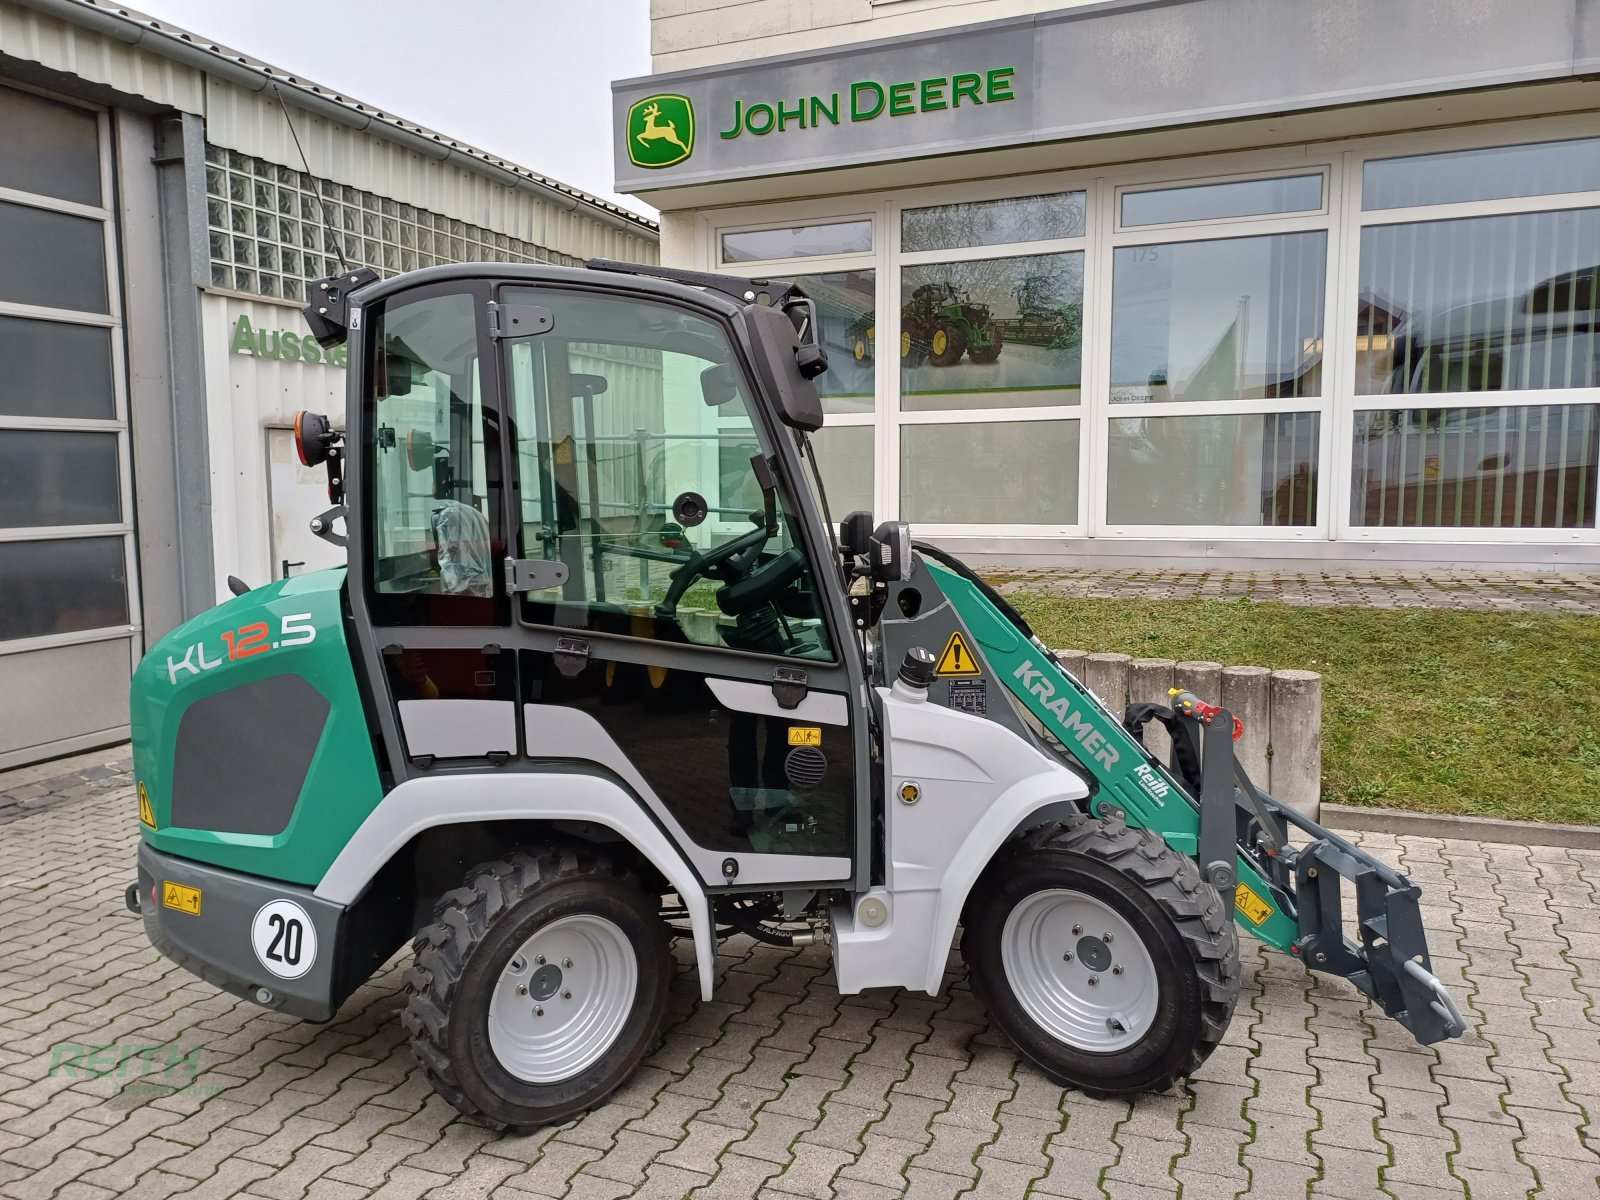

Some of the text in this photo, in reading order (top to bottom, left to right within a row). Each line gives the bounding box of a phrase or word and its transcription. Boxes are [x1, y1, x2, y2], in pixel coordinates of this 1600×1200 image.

[720, 66, 1016, 140] JOHN DEERE
[1012, 659, 1120, 773] KRAMER
[1133, 763, 1170, 798] Reith
[266, 913, 303, 967] 20
